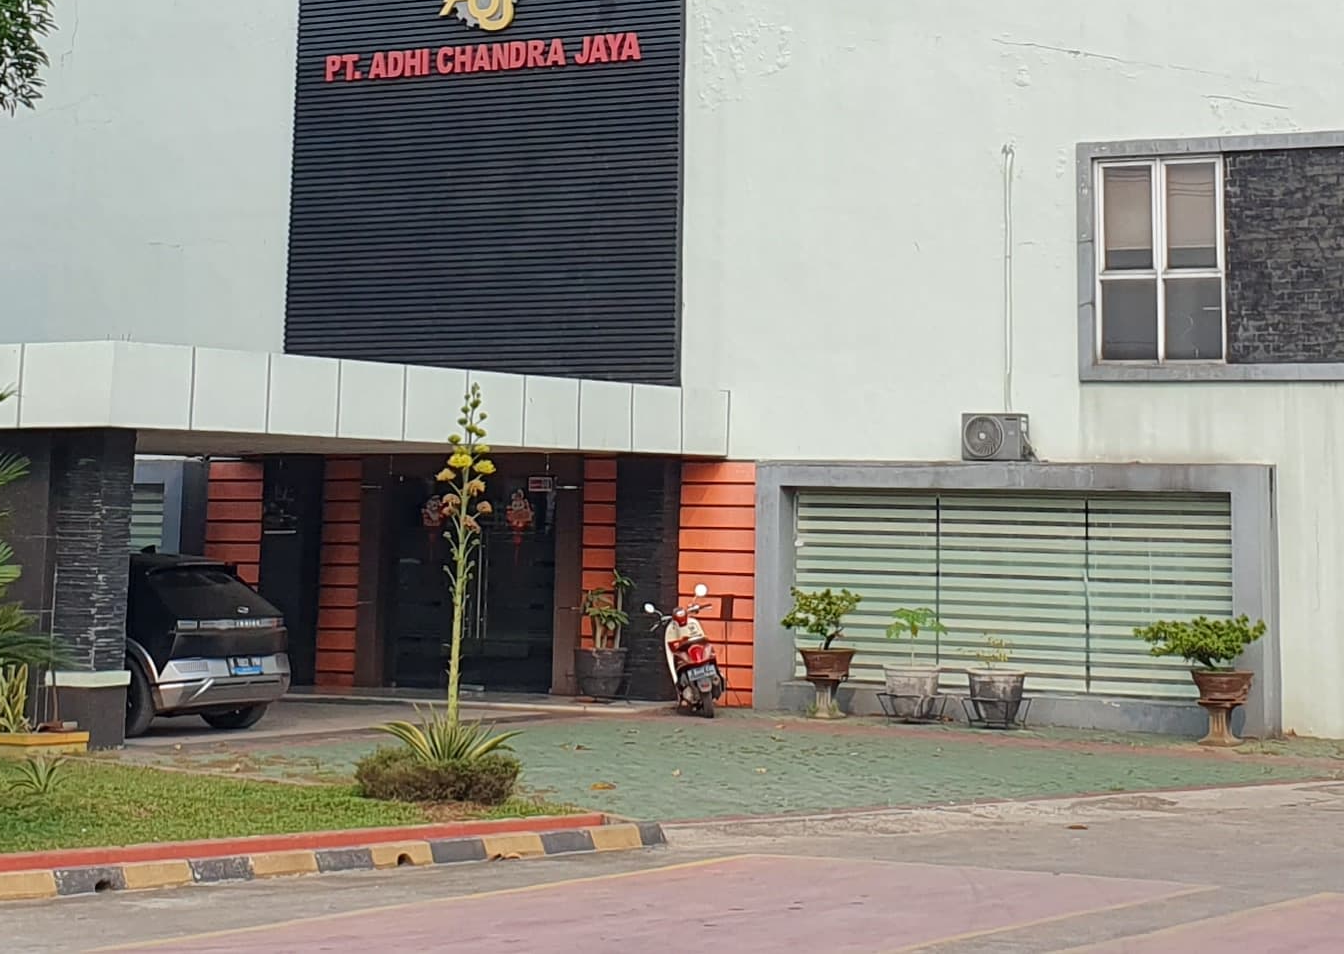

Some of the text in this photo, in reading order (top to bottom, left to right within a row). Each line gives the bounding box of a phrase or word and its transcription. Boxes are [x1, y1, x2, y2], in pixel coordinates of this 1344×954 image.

[324, 32, 642, 82] PT. ADHI CHANDRA JAYA
